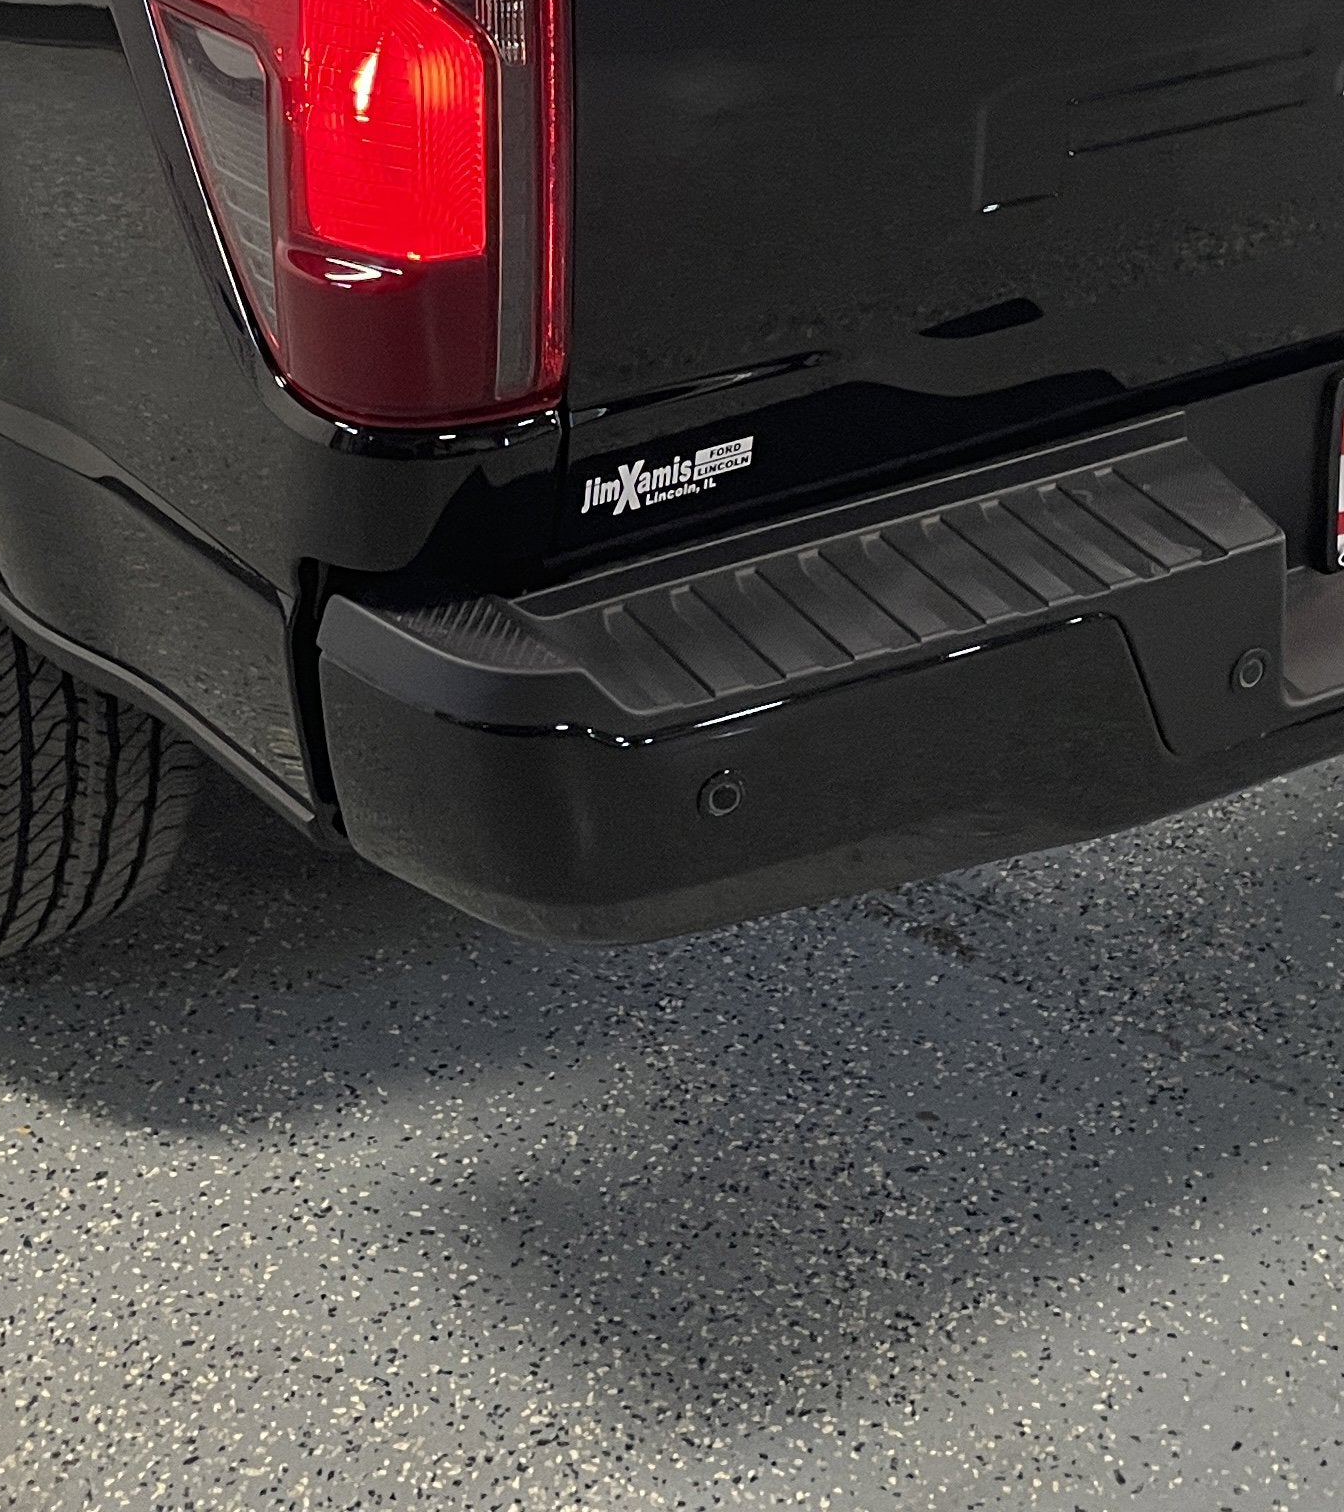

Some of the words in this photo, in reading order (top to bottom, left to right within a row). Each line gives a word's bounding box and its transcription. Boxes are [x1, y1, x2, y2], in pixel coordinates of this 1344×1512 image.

[709, 442, 742, 459] FORD
[697, 454, 750, 477] LINCOLN
[645, 482, 700, 506] Lincoln,
[703, 477, 717, 490] IL
